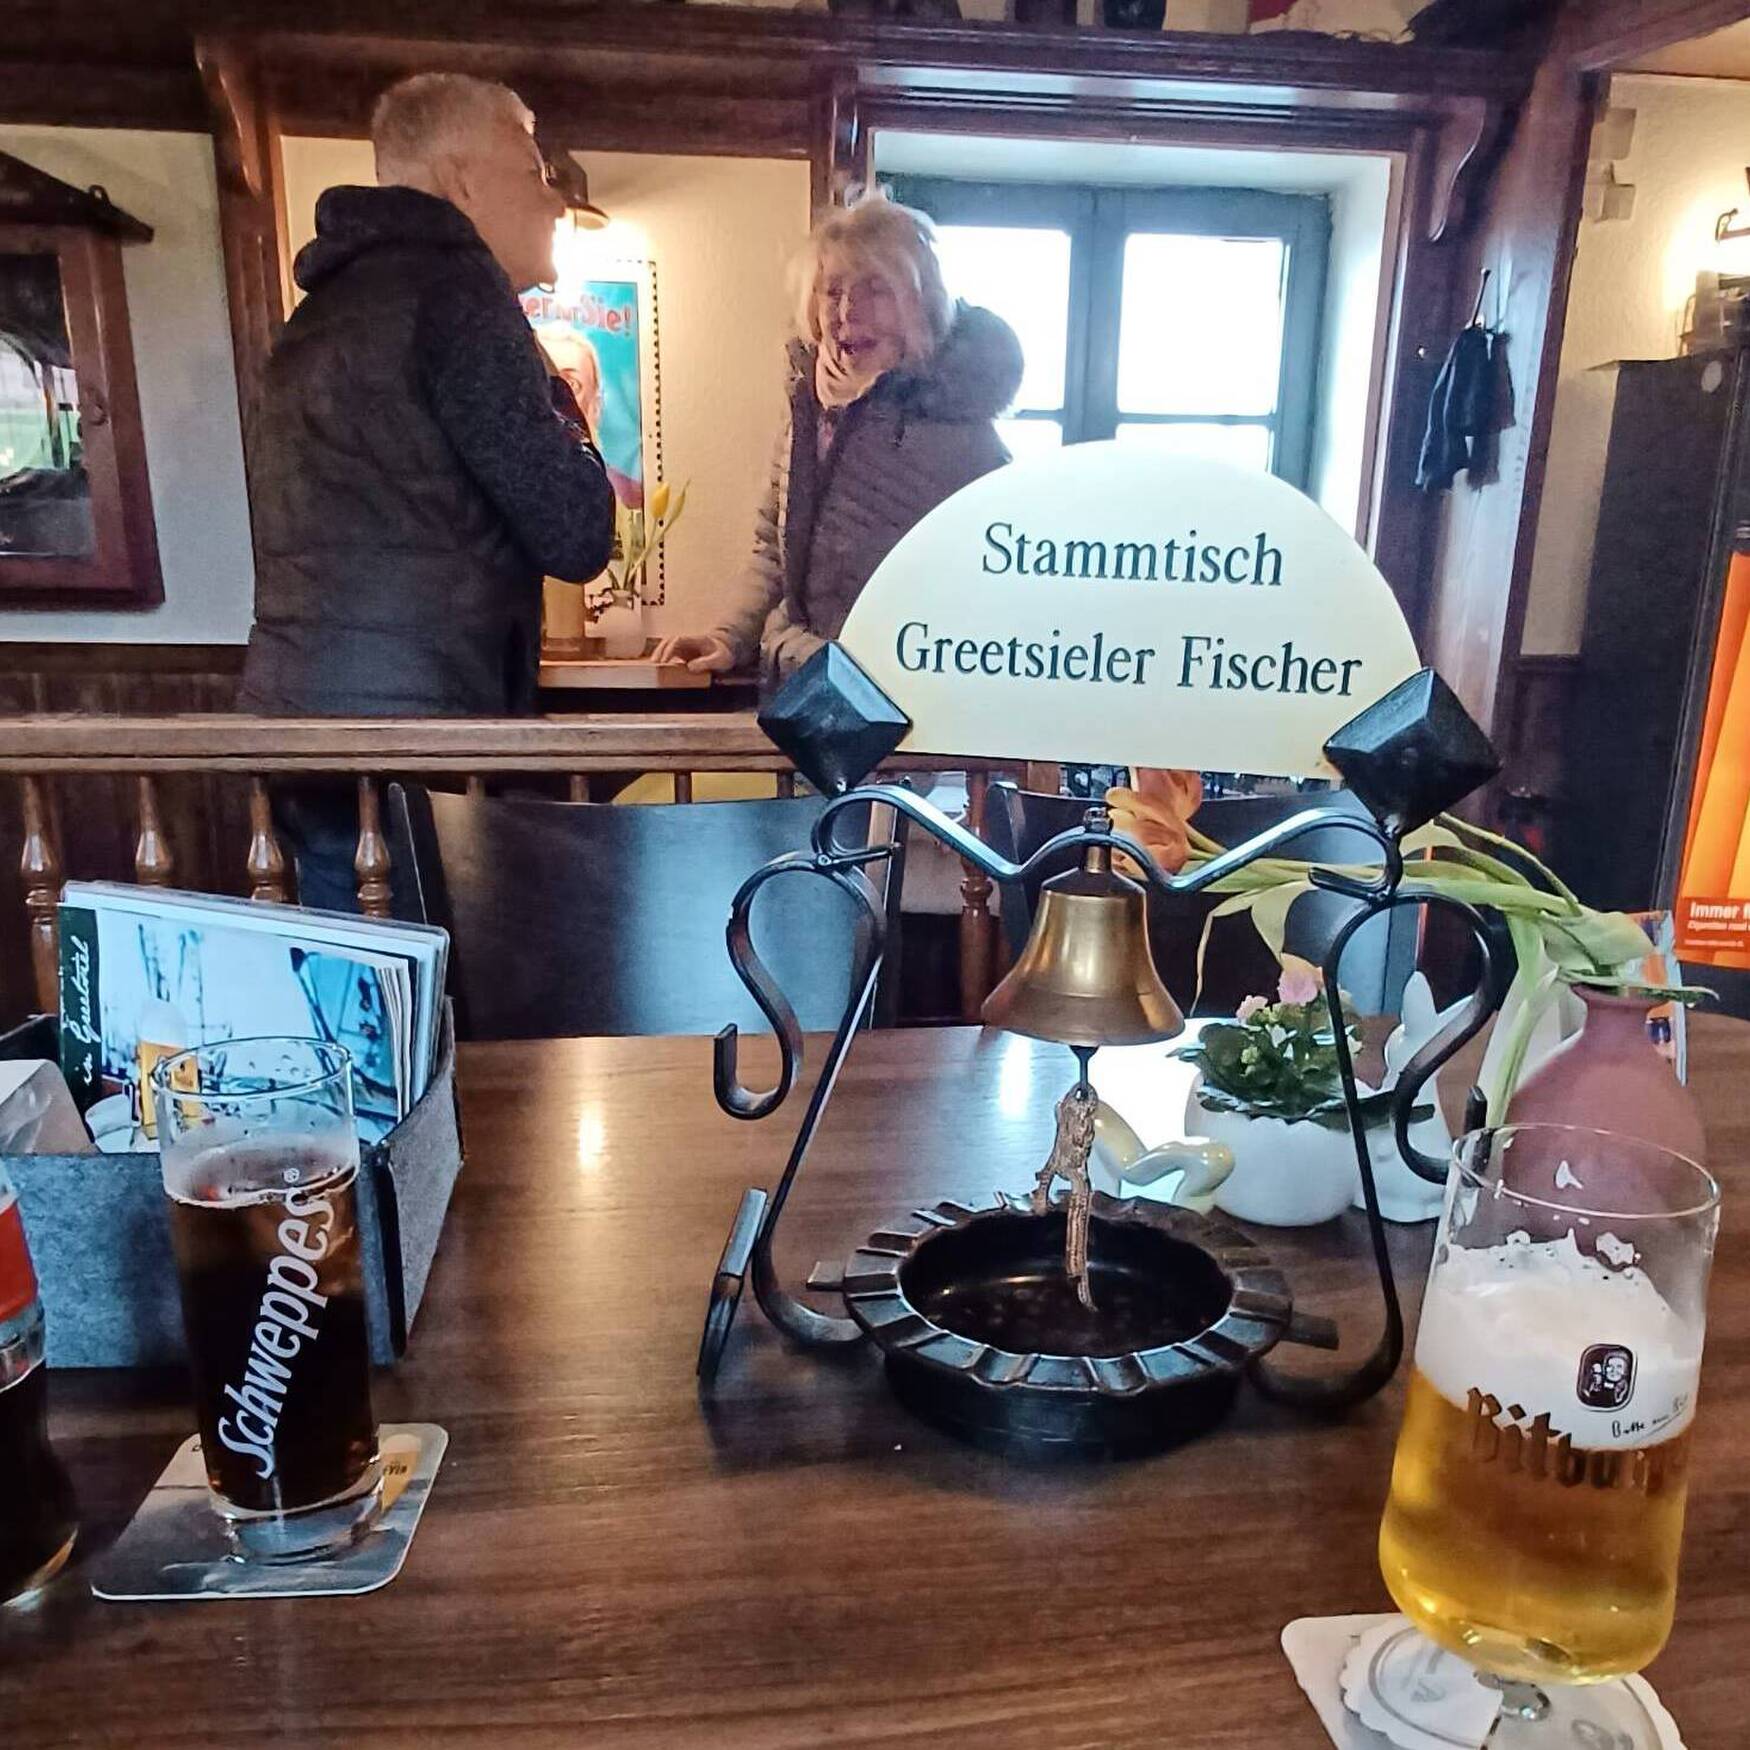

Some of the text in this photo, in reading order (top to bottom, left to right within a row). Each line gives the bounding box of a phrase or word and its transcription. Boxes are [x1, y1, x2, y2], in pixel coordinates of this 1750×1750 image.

[984, 523, 1281, 585] Stammtisch
[897, 622, 1363, 696] Greetsieler Fischer
[1690, 901, 1739, 919] Immer
[218, 1188, 334, 1479] Schweppes
